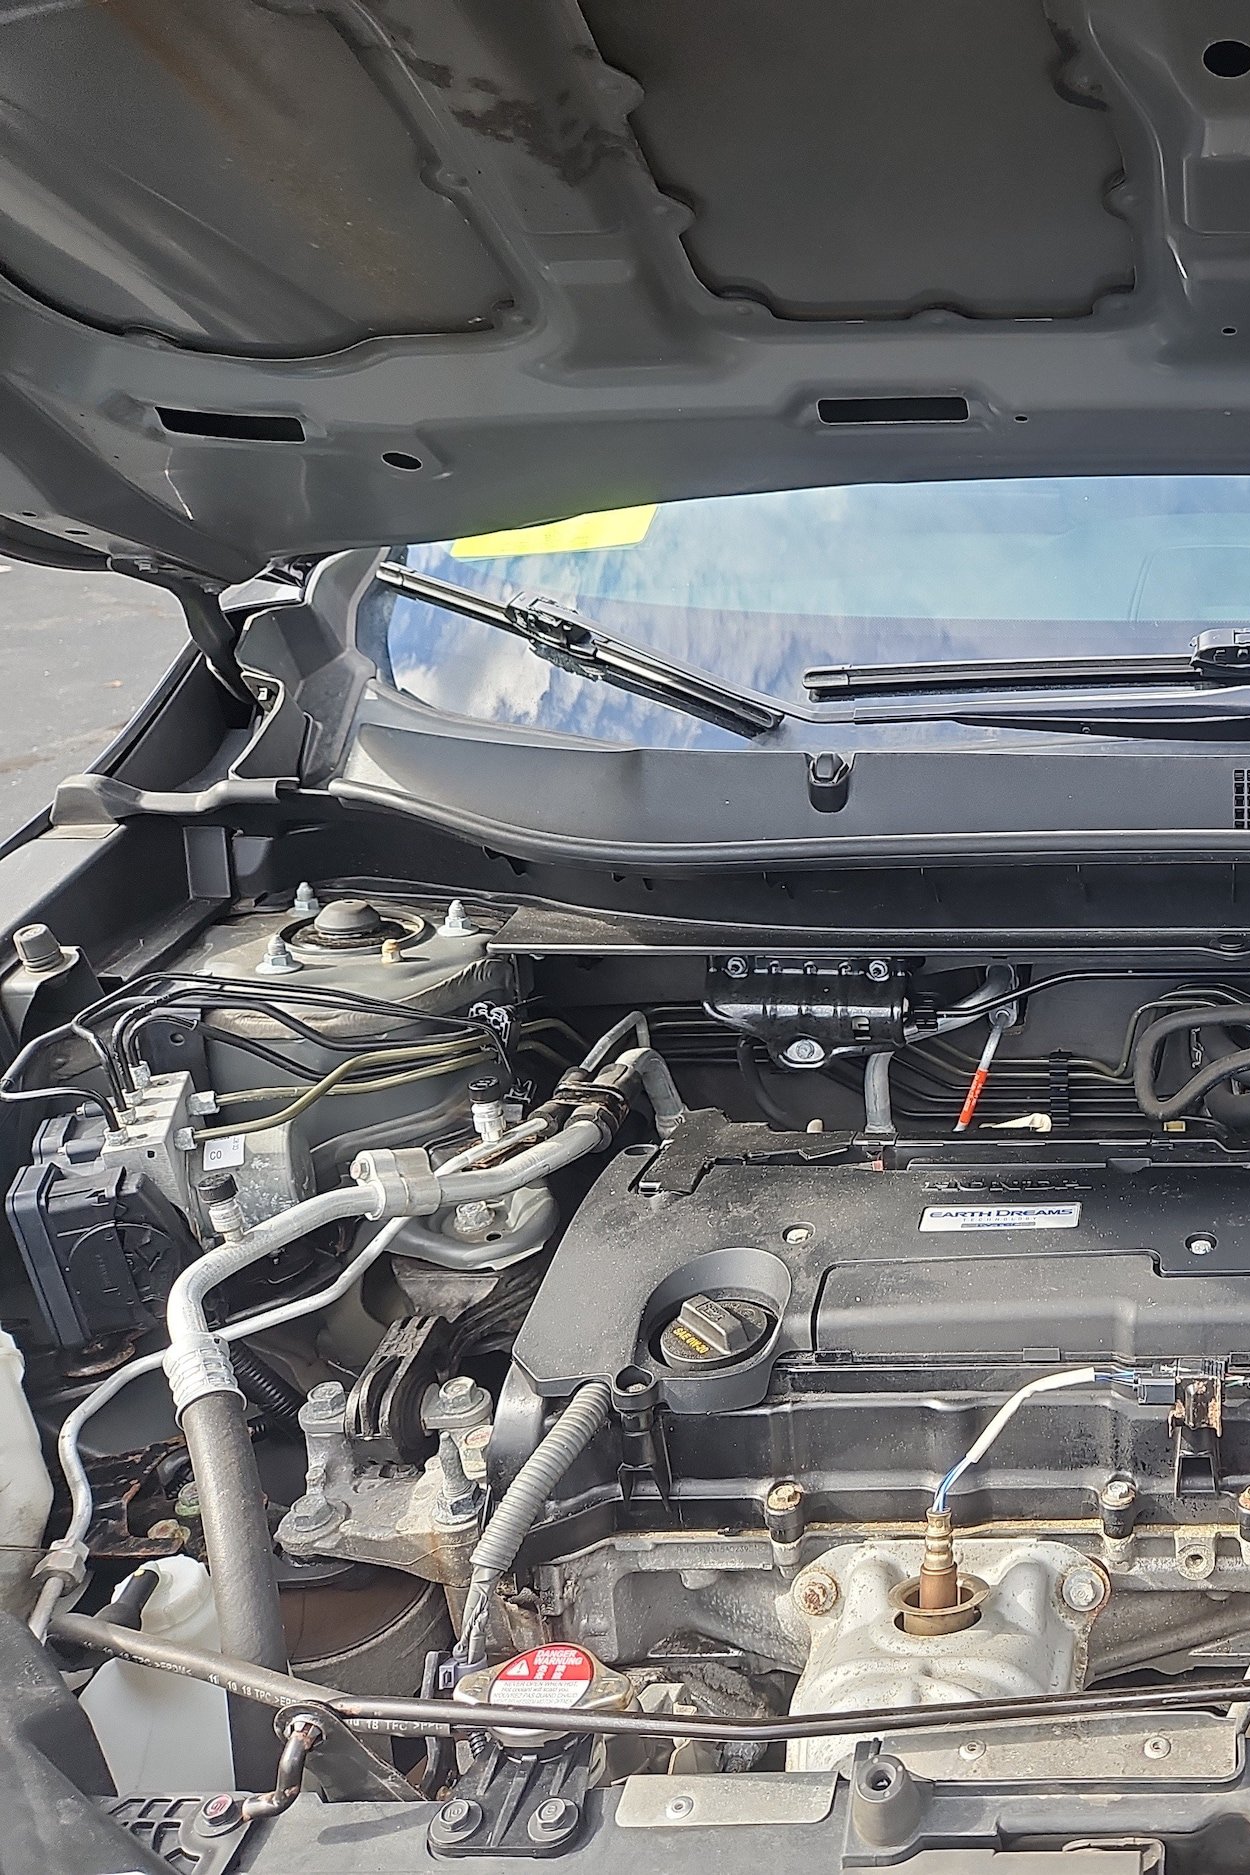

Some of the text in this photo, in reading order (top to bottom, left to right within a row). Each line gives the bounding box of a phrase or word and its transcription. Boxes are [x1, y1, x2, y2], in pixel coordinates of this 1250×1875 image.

[929, 1208, 1073, 1218] EARTH DREAMS
[672, 1326, 711, 1355] SAE 0W-20
[536, 1650, 579, 1658] DANGER
[533, 1657, 584, 1665] WARNUNG
[226, 1680, 238, 1691] 10
[242, 1685, 252, 1696] 18
[254, 1688, 272, 1702] TPC
